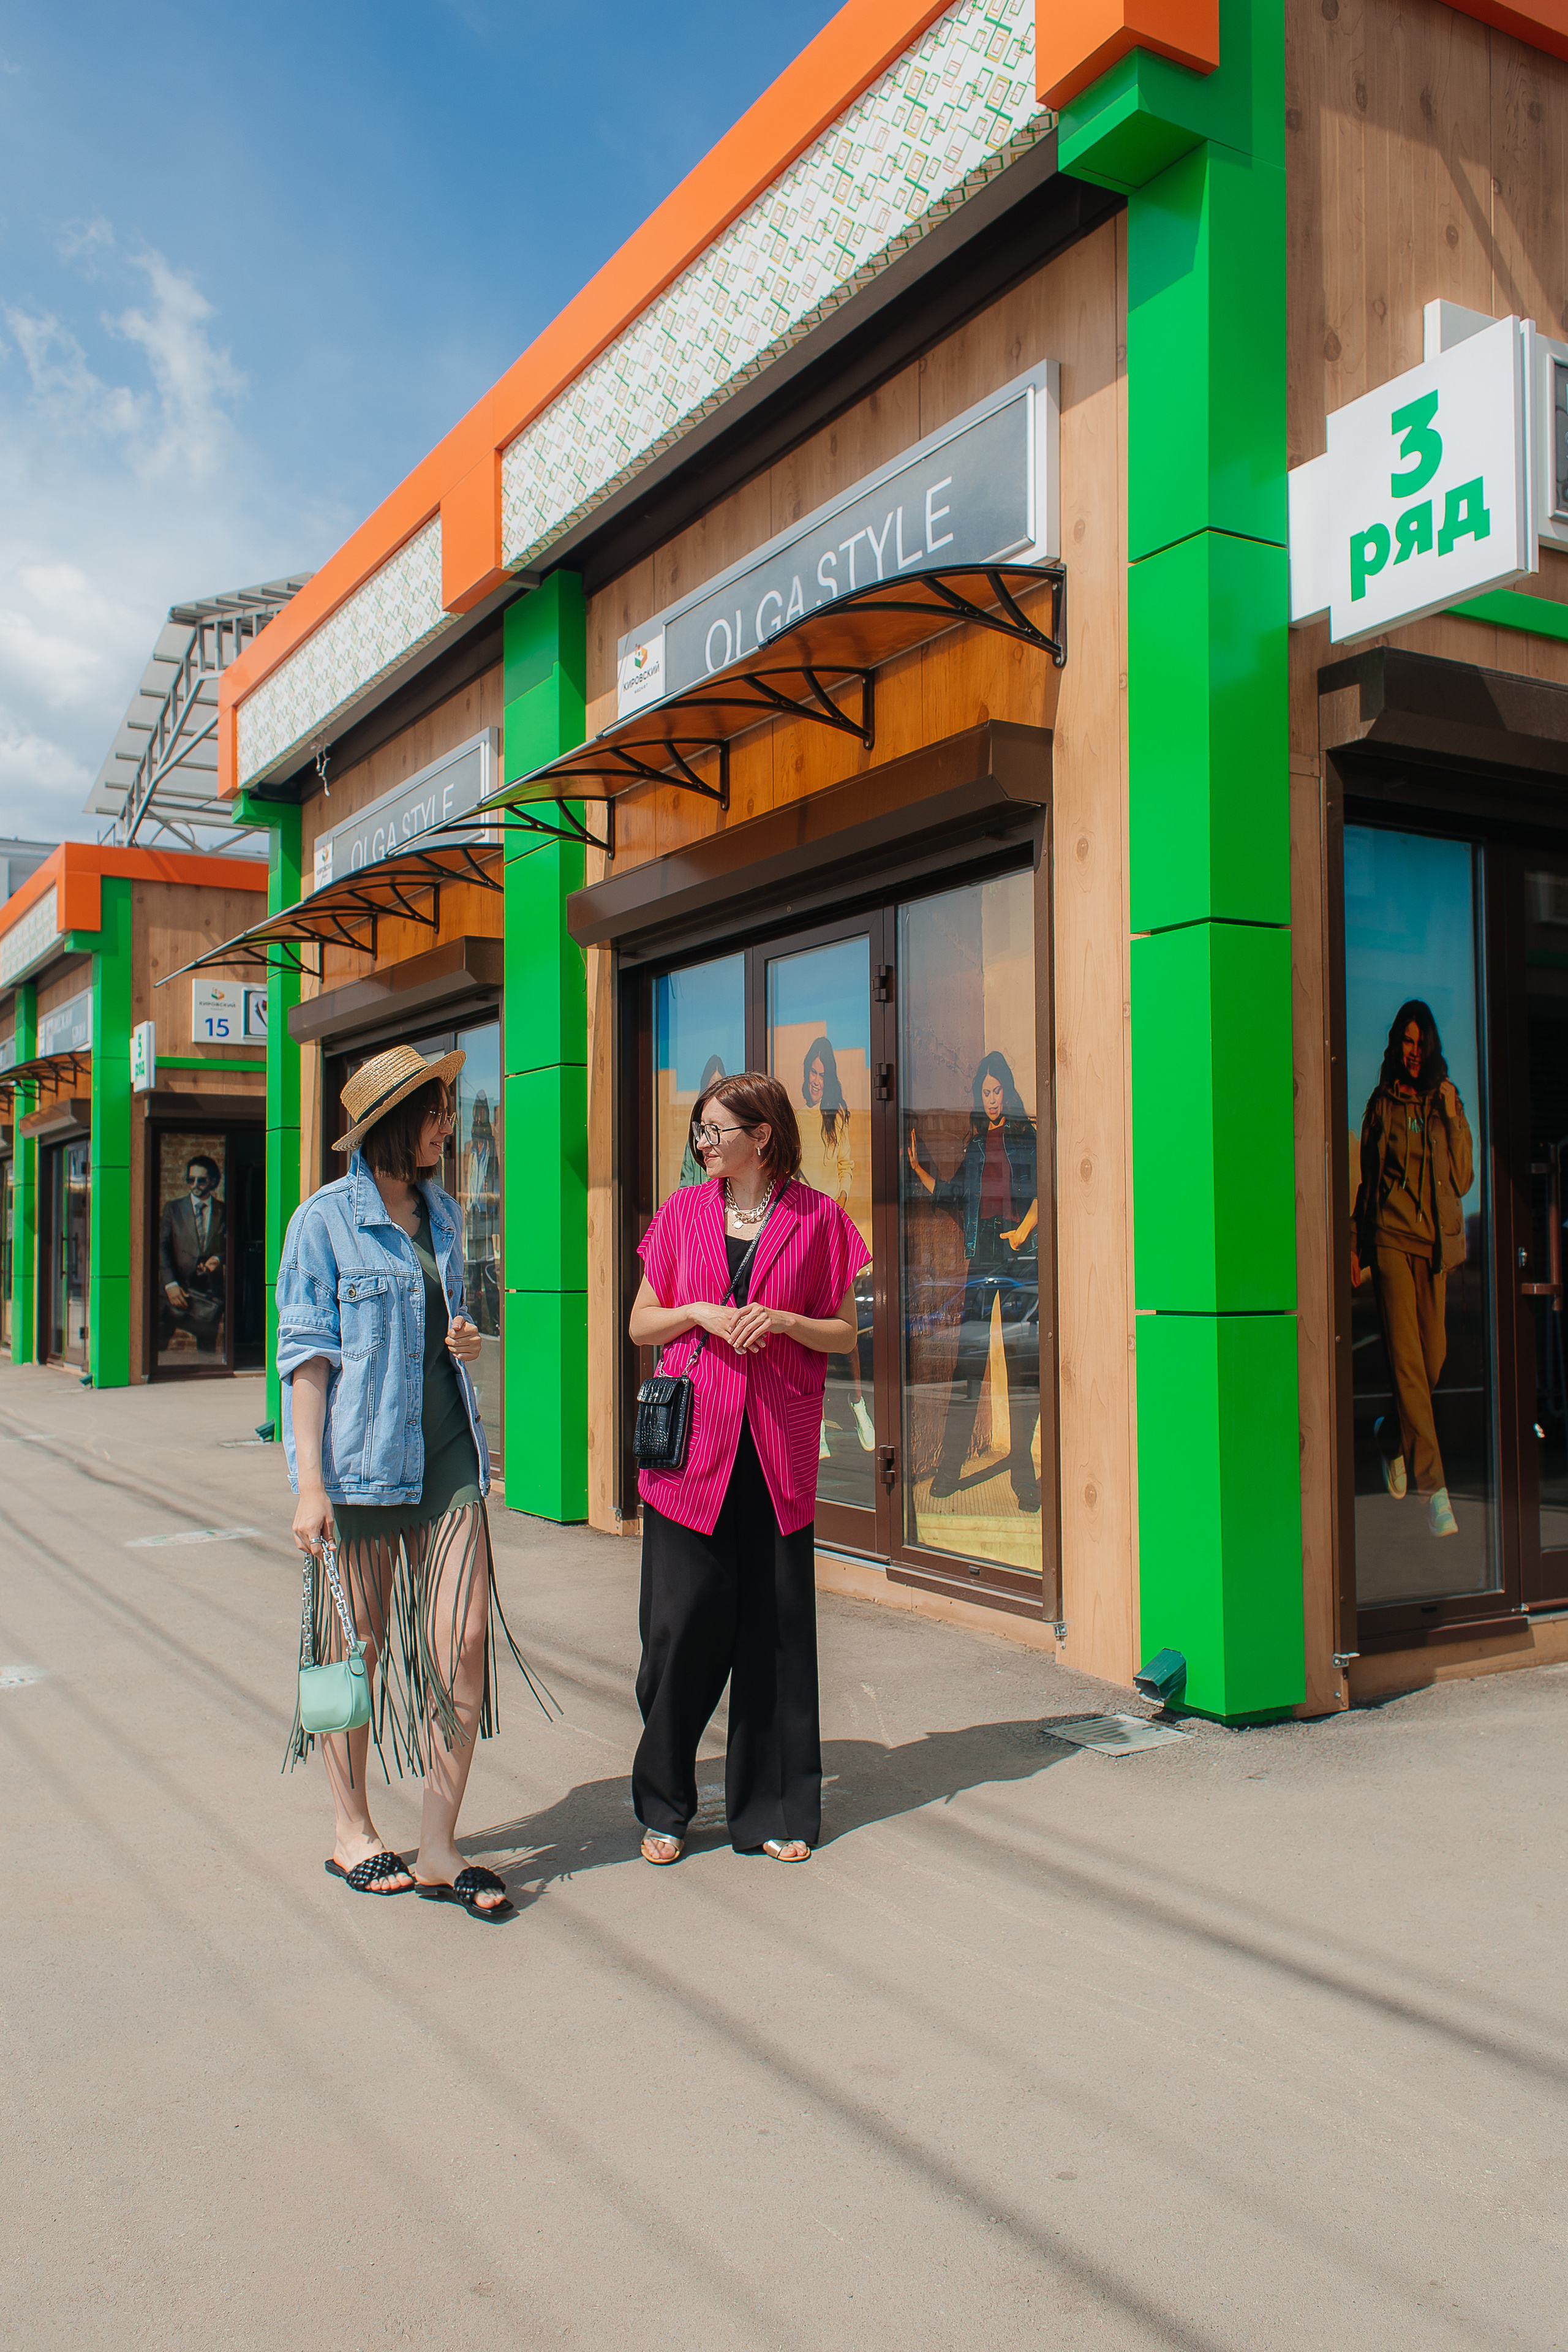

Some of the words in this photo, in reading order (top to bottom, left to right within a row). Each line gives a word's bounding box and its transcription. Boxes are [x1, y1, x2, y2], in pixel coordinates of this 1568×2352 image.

[1391, 388, 1443, 499] 3
[816, 475, 954, 606] STYLE
[1349, 475, 1491, 603] ряд
[622, 661, 660, 692] КИРОВСКИЙ
[205, 1017, 230, 1037] 15
